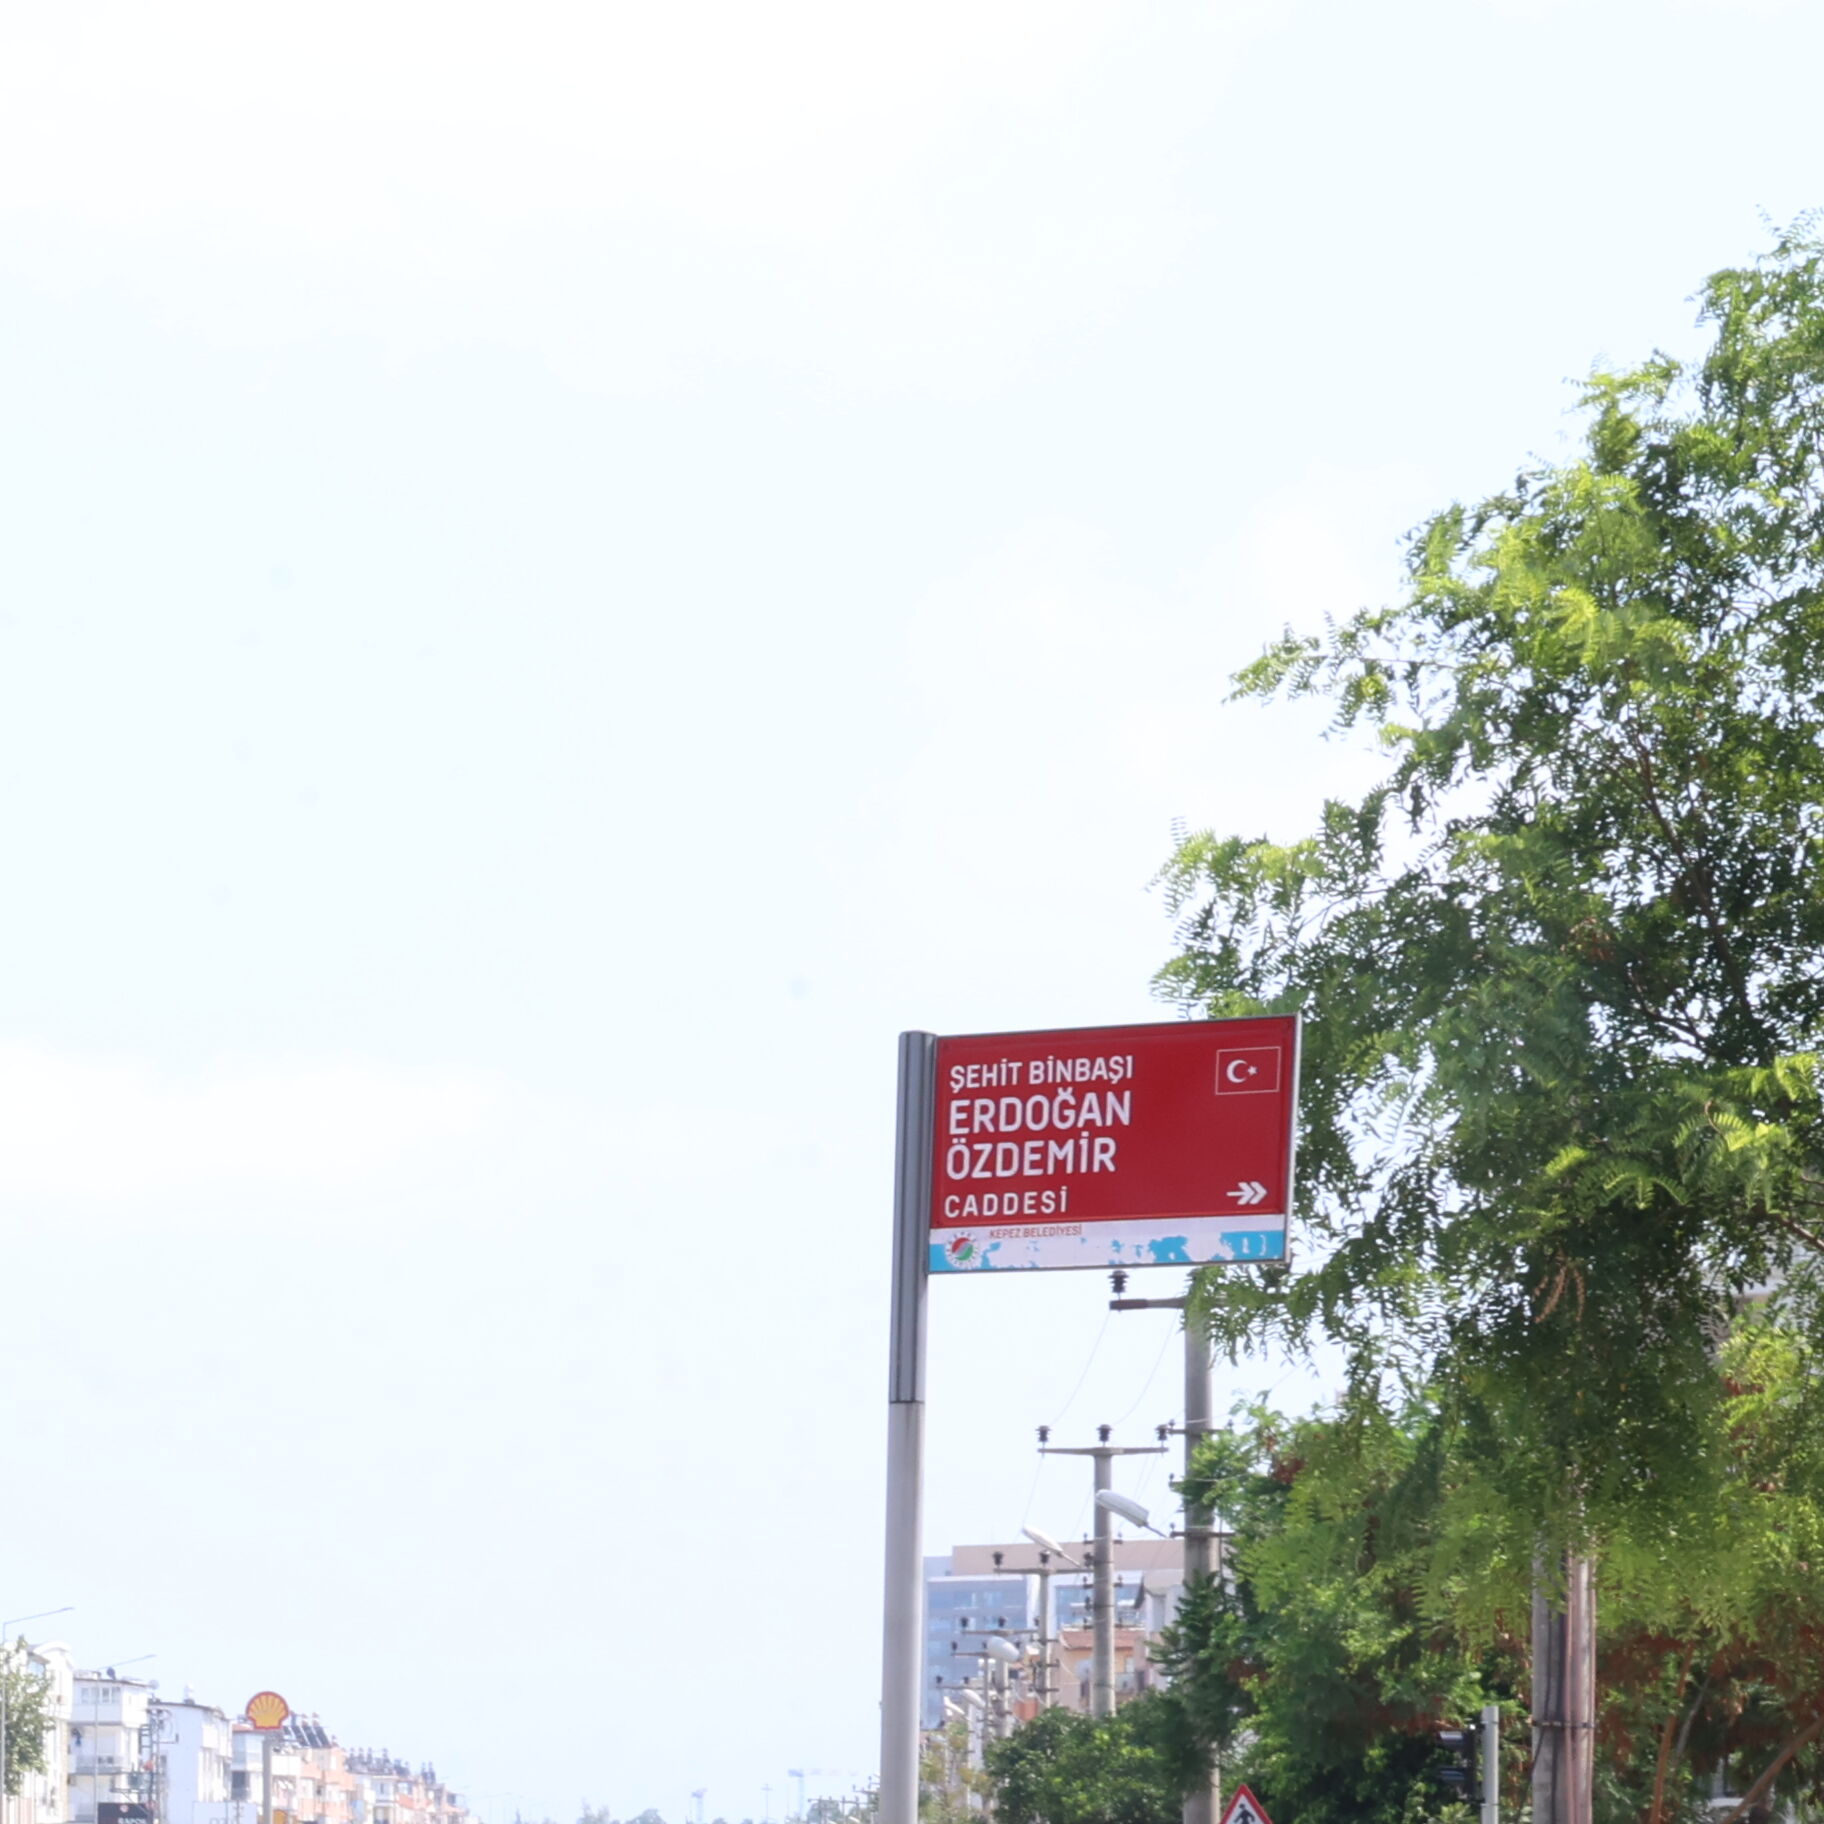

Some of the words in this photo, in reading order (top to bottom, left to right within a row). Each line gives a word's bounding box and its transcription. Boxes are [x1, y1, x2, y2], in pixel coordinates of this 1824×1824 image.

[949, 1057, 1023, 1093] ŞEHİT
[1029, 1055, 1134, 1086] BİNBAŞI
[948, 1088, 1132, 1135] ERDOĞAN
[946, 1131, 1117, 1180] ÖZDEMİR
[944, 1186, 1069, 1218] CADDESİ
[989, 1227, 1021, 1239] KEPEZ
[1023, 1224, 1083, 1238] BELEDİYESİ
